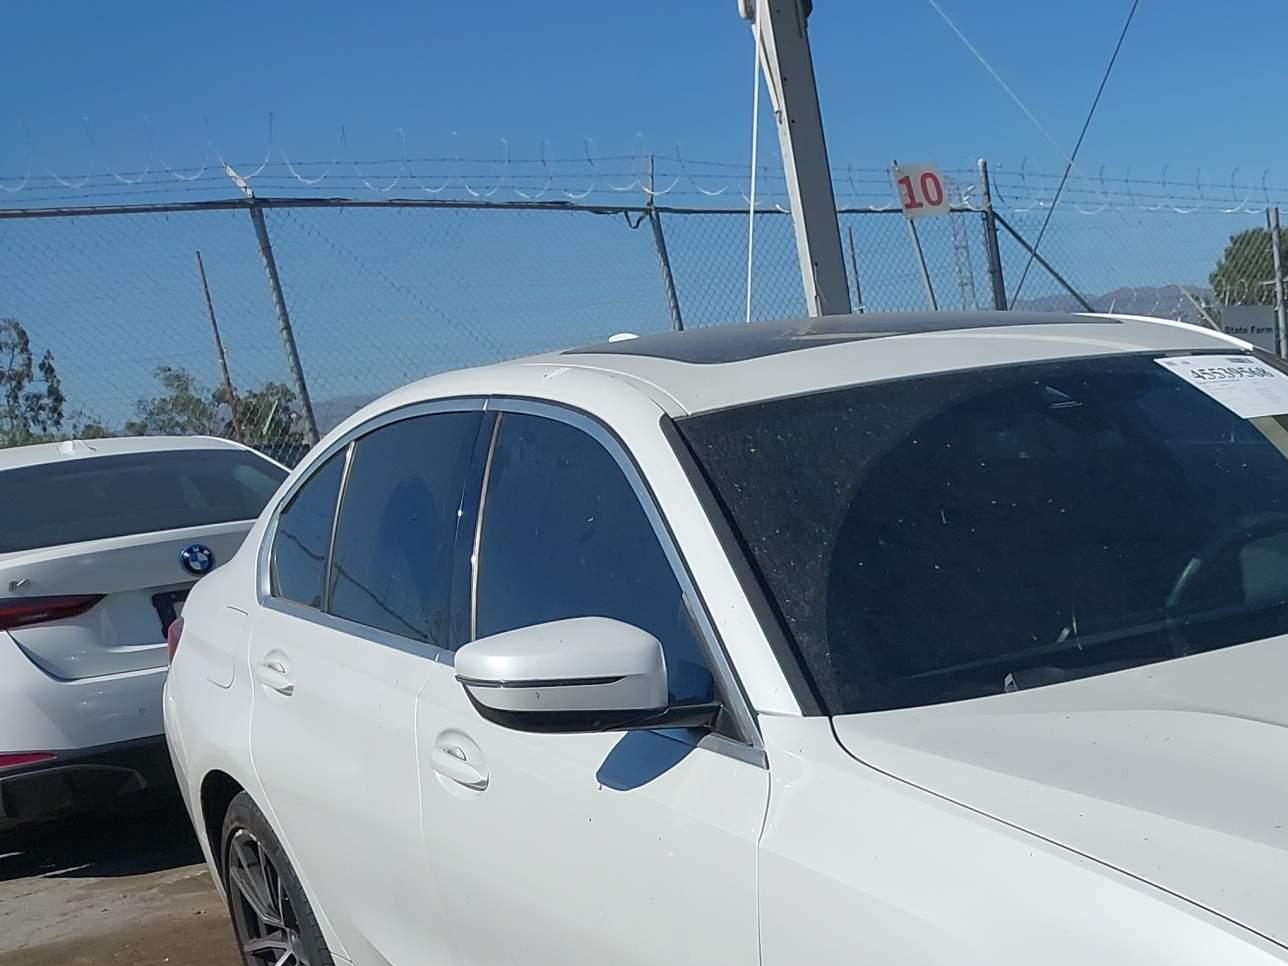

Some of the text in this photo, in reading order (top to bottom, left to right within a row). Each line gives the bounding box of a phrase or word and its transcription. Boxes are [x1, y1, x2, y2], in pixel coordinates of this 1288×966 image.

[897, 172, 944, 209] 10
[1224, 325, 1273, 335] State Farm
[1189, 366, 1276, 381] 45539568
